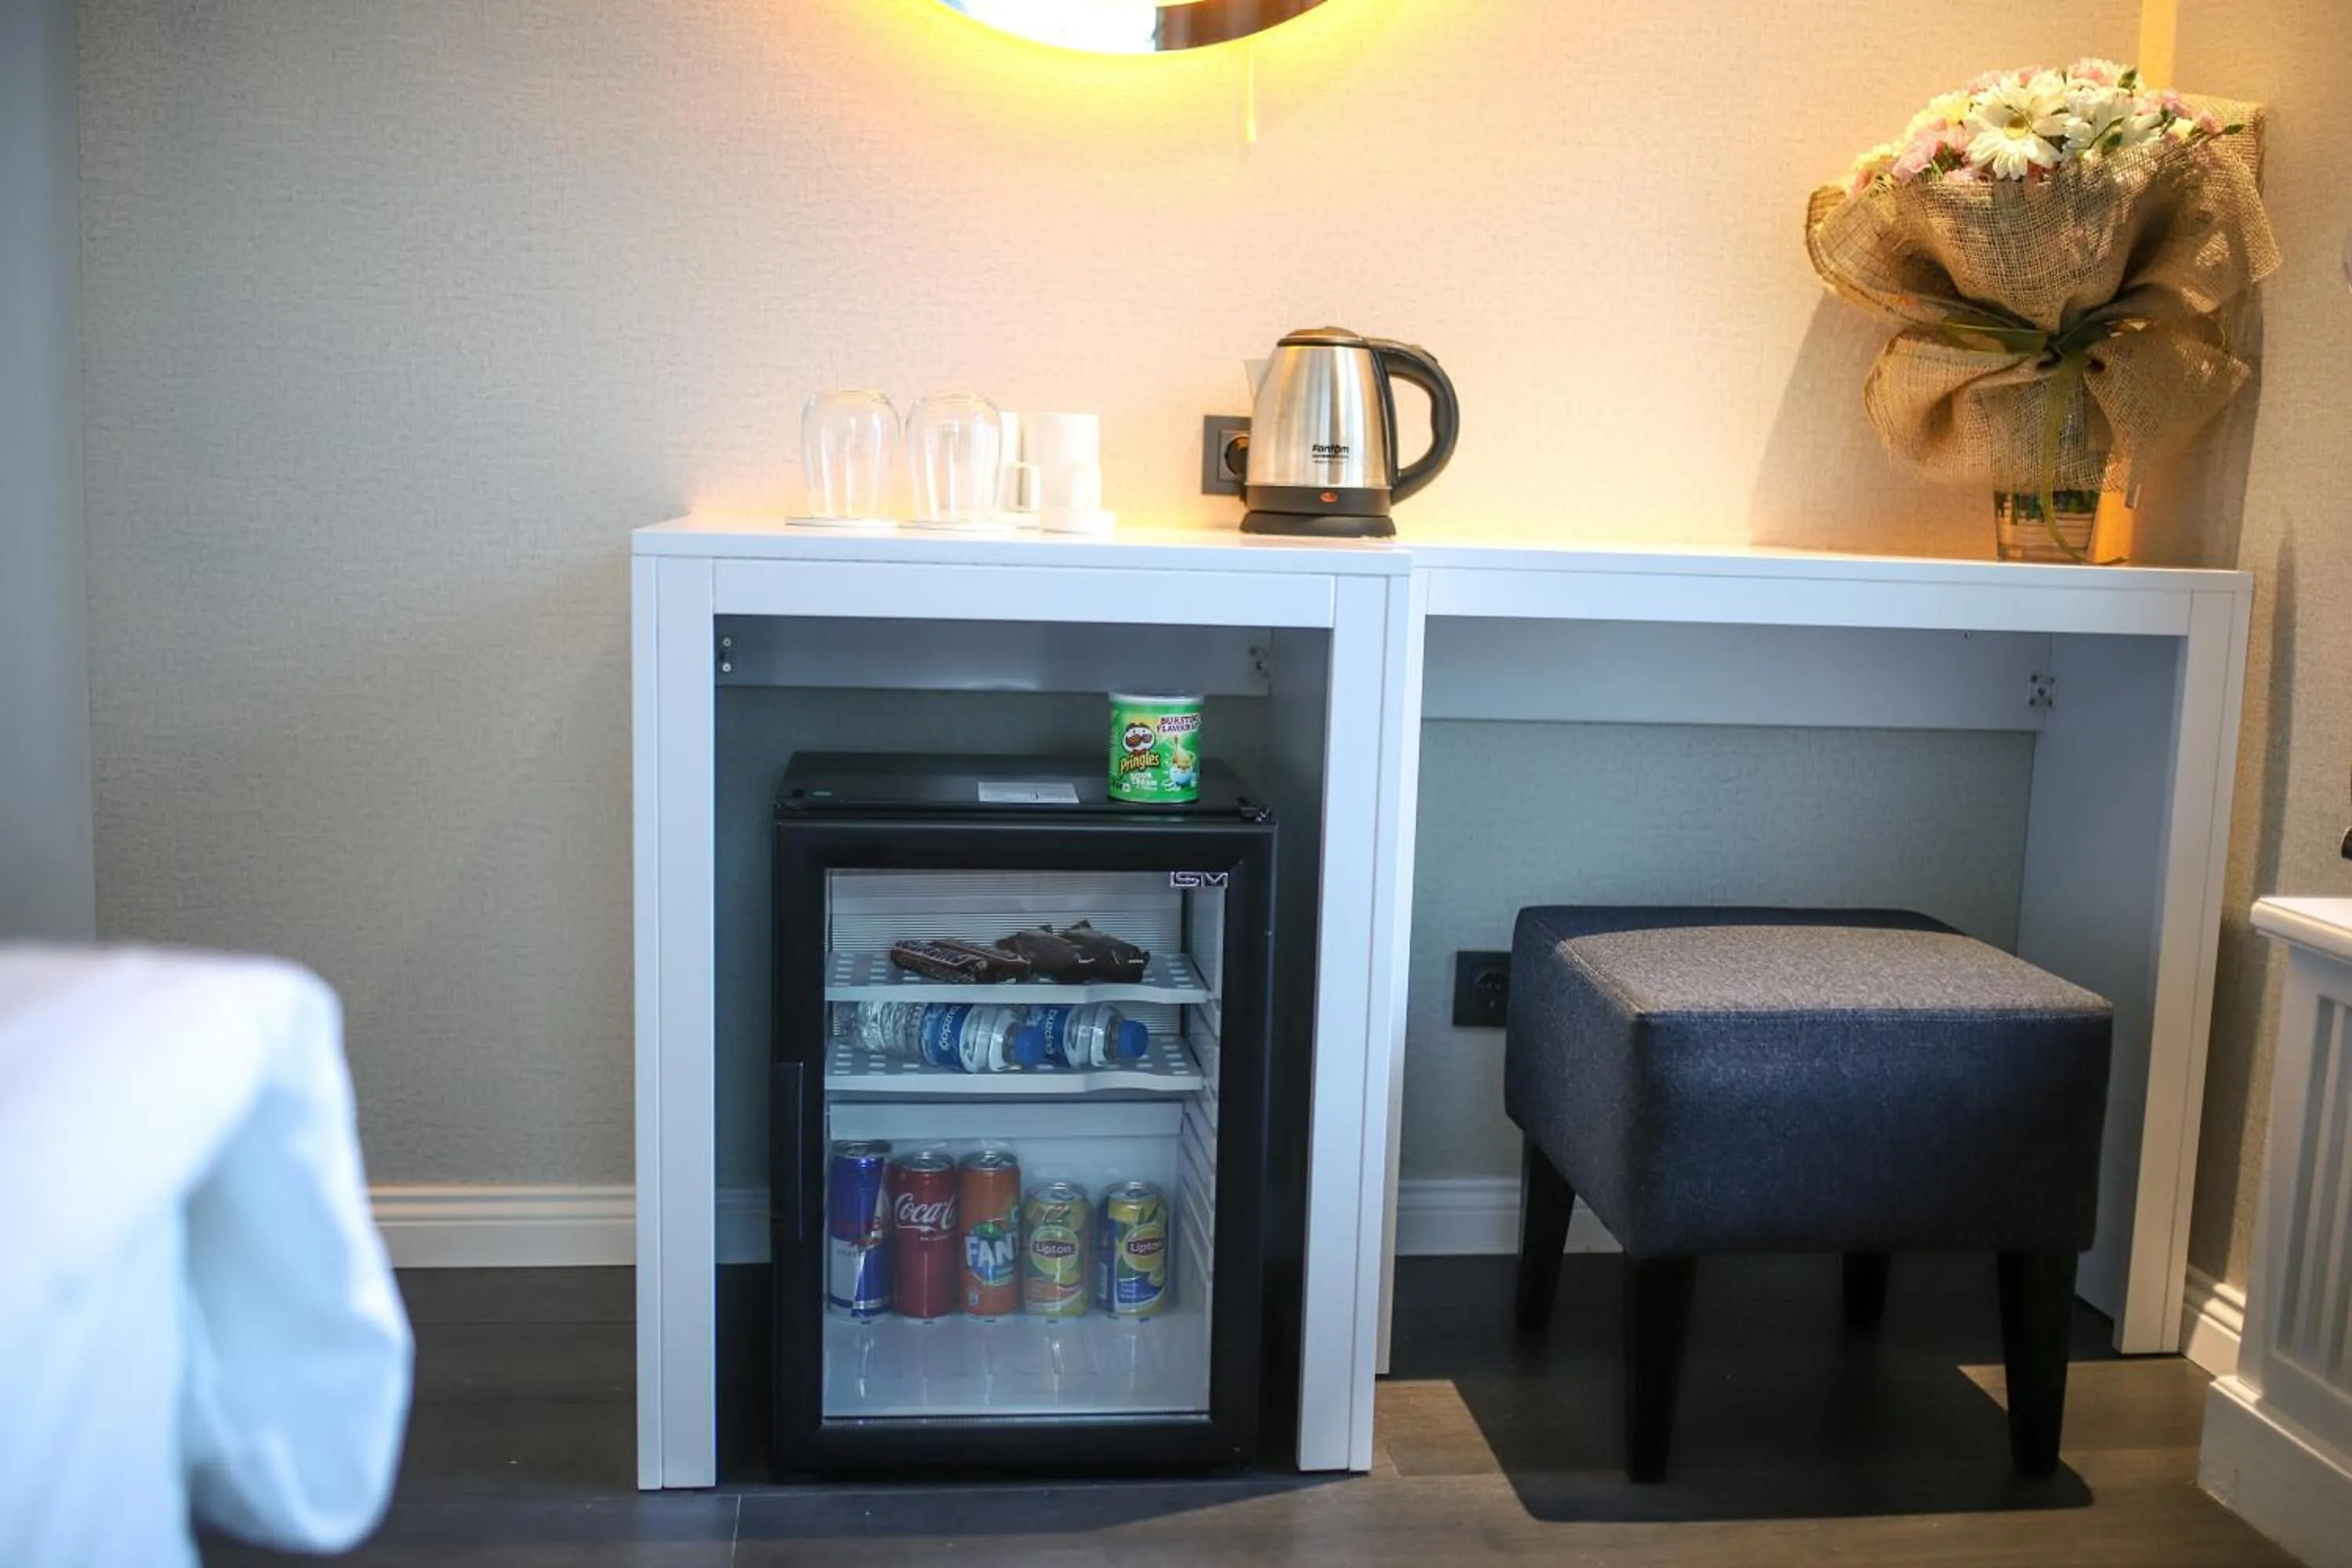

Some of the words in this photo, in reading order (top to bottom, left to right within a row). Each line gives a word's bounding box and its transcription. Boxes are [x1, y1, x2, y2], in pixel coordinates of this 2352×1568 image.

[1120, 751, 1160, 775] Pringles
[965, 1231, 1018, 1268] FAN
[1036, 1243, 1072, 1255] Lipton
